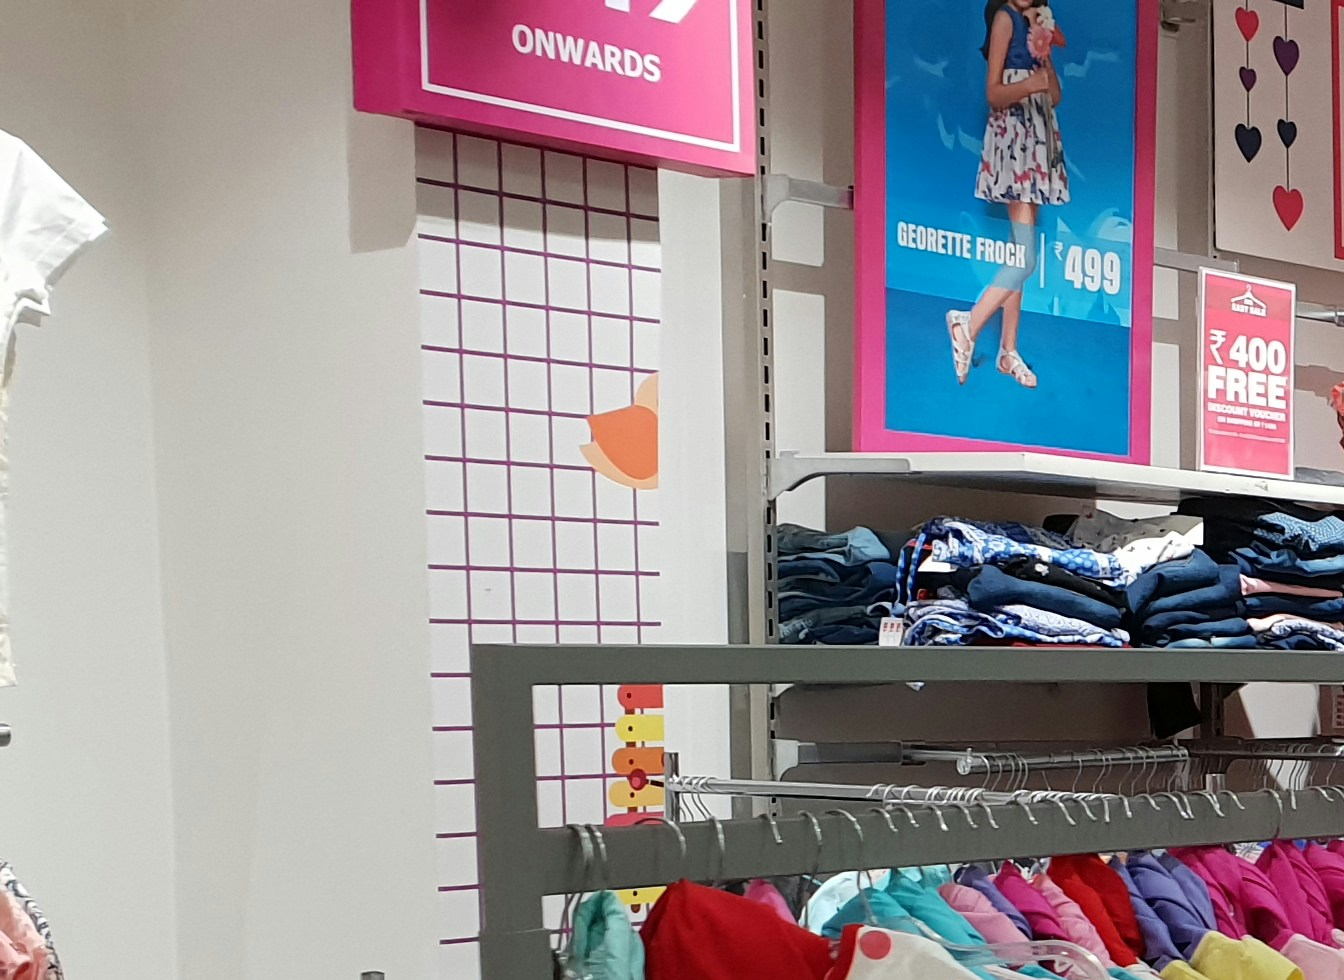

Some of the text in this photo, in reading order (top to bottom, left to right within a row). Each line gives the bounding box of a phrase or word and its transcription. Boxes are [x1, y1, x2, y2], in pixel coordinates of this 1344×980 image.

[511, 24, 662, 83] ONWARDS
[897, 221, 1026, 269] GEORETTE FROCK
[1207, 365, 1288, 410] FREE
